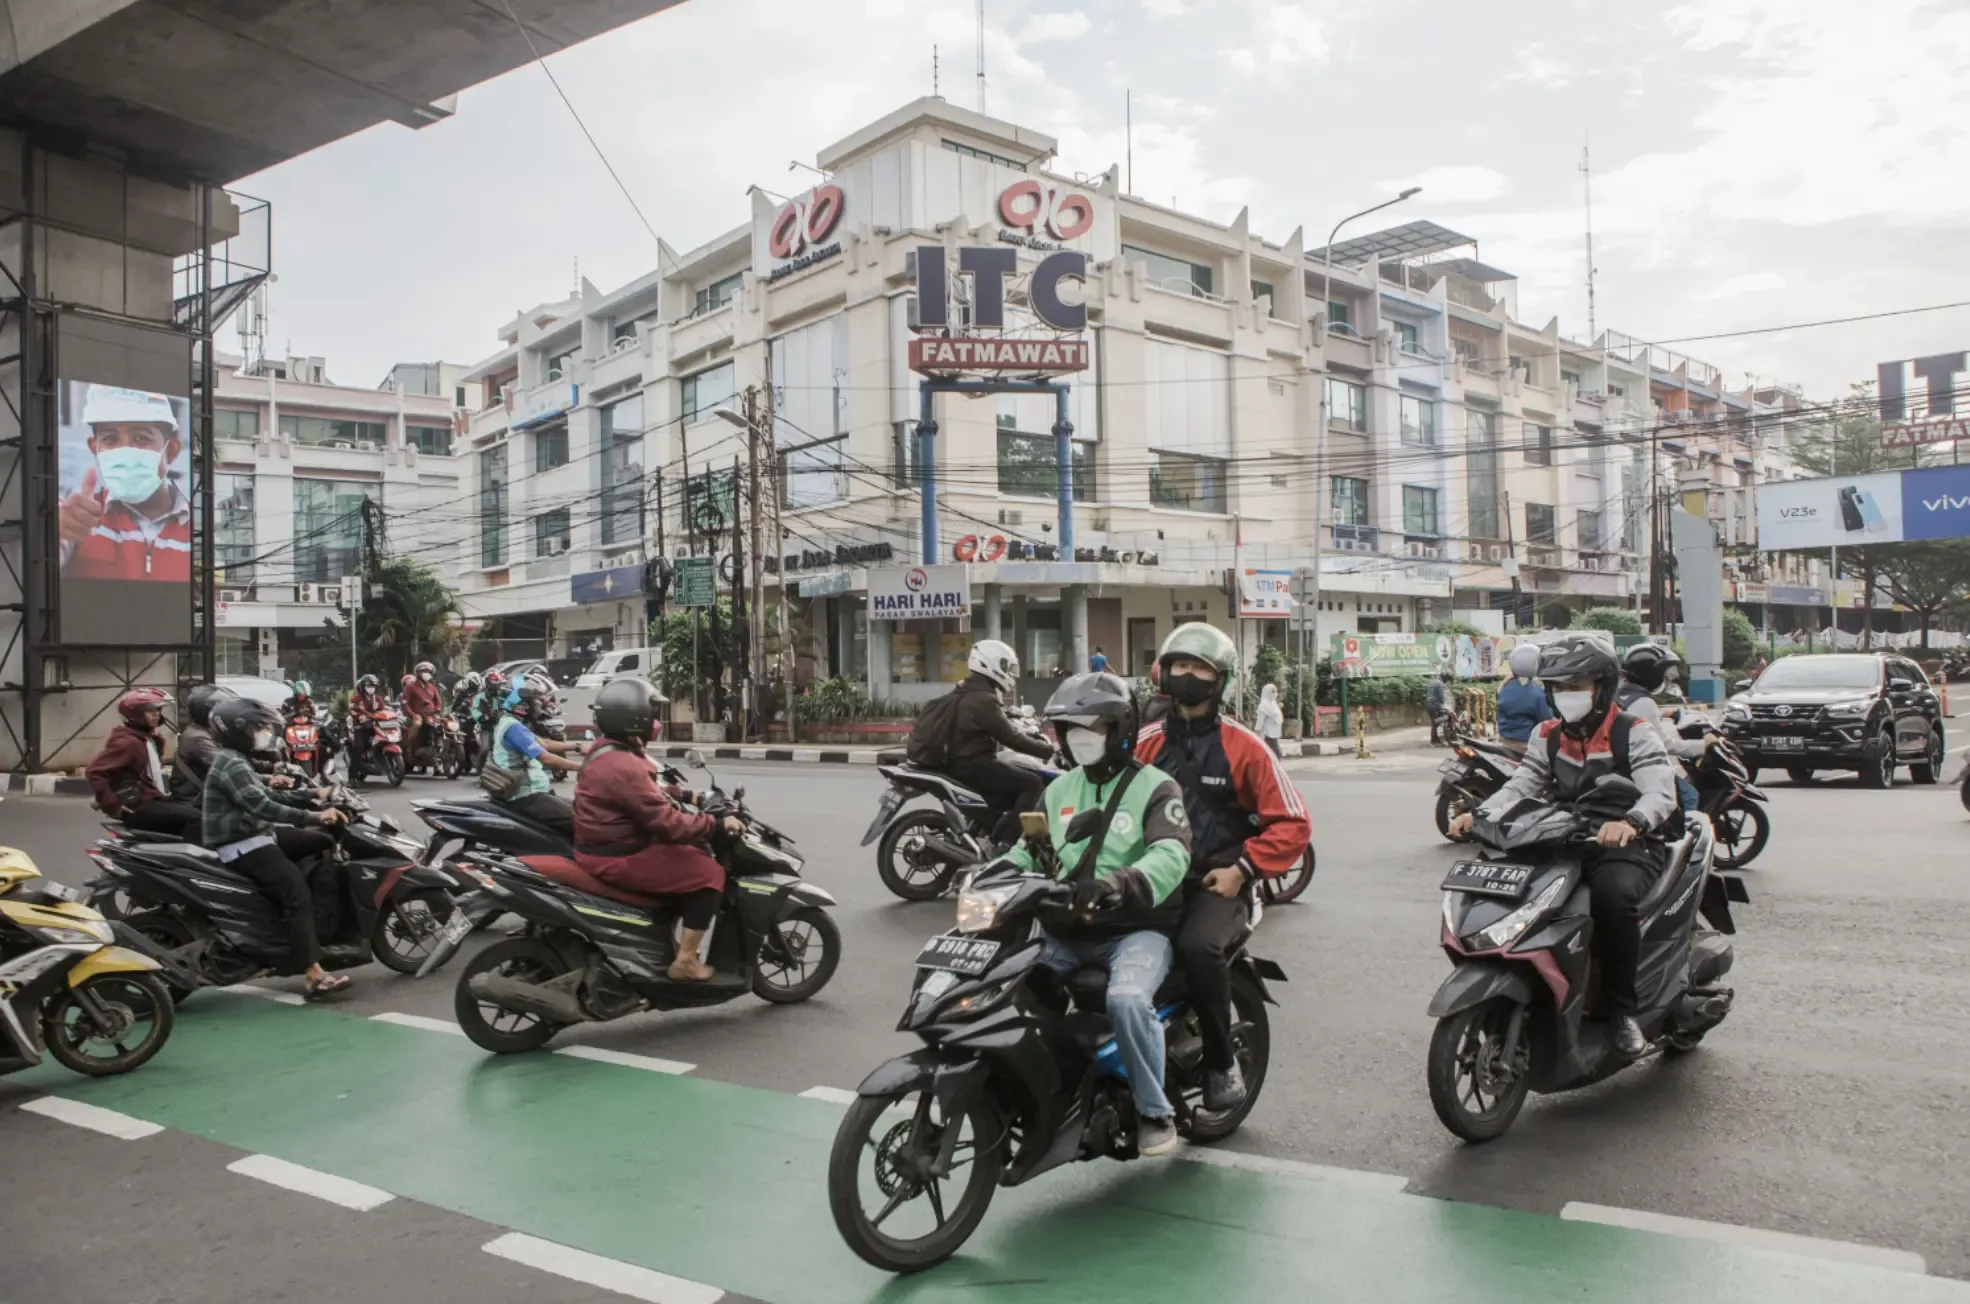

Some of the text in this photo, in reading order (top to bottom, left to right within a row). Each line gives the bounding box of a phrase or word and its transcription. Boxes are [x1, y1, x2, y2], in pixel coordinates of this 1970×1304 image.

[917, 246, 1086, 332] ITC
[922, 342, 1087, 364] FATMAWATI
[1780, 506, 1817, 518] V23e
[873, 592, 961, 610] HARI HARI
[1453, 864, 1465, 875] F
[1500, 868, 1526, 882] FAP
